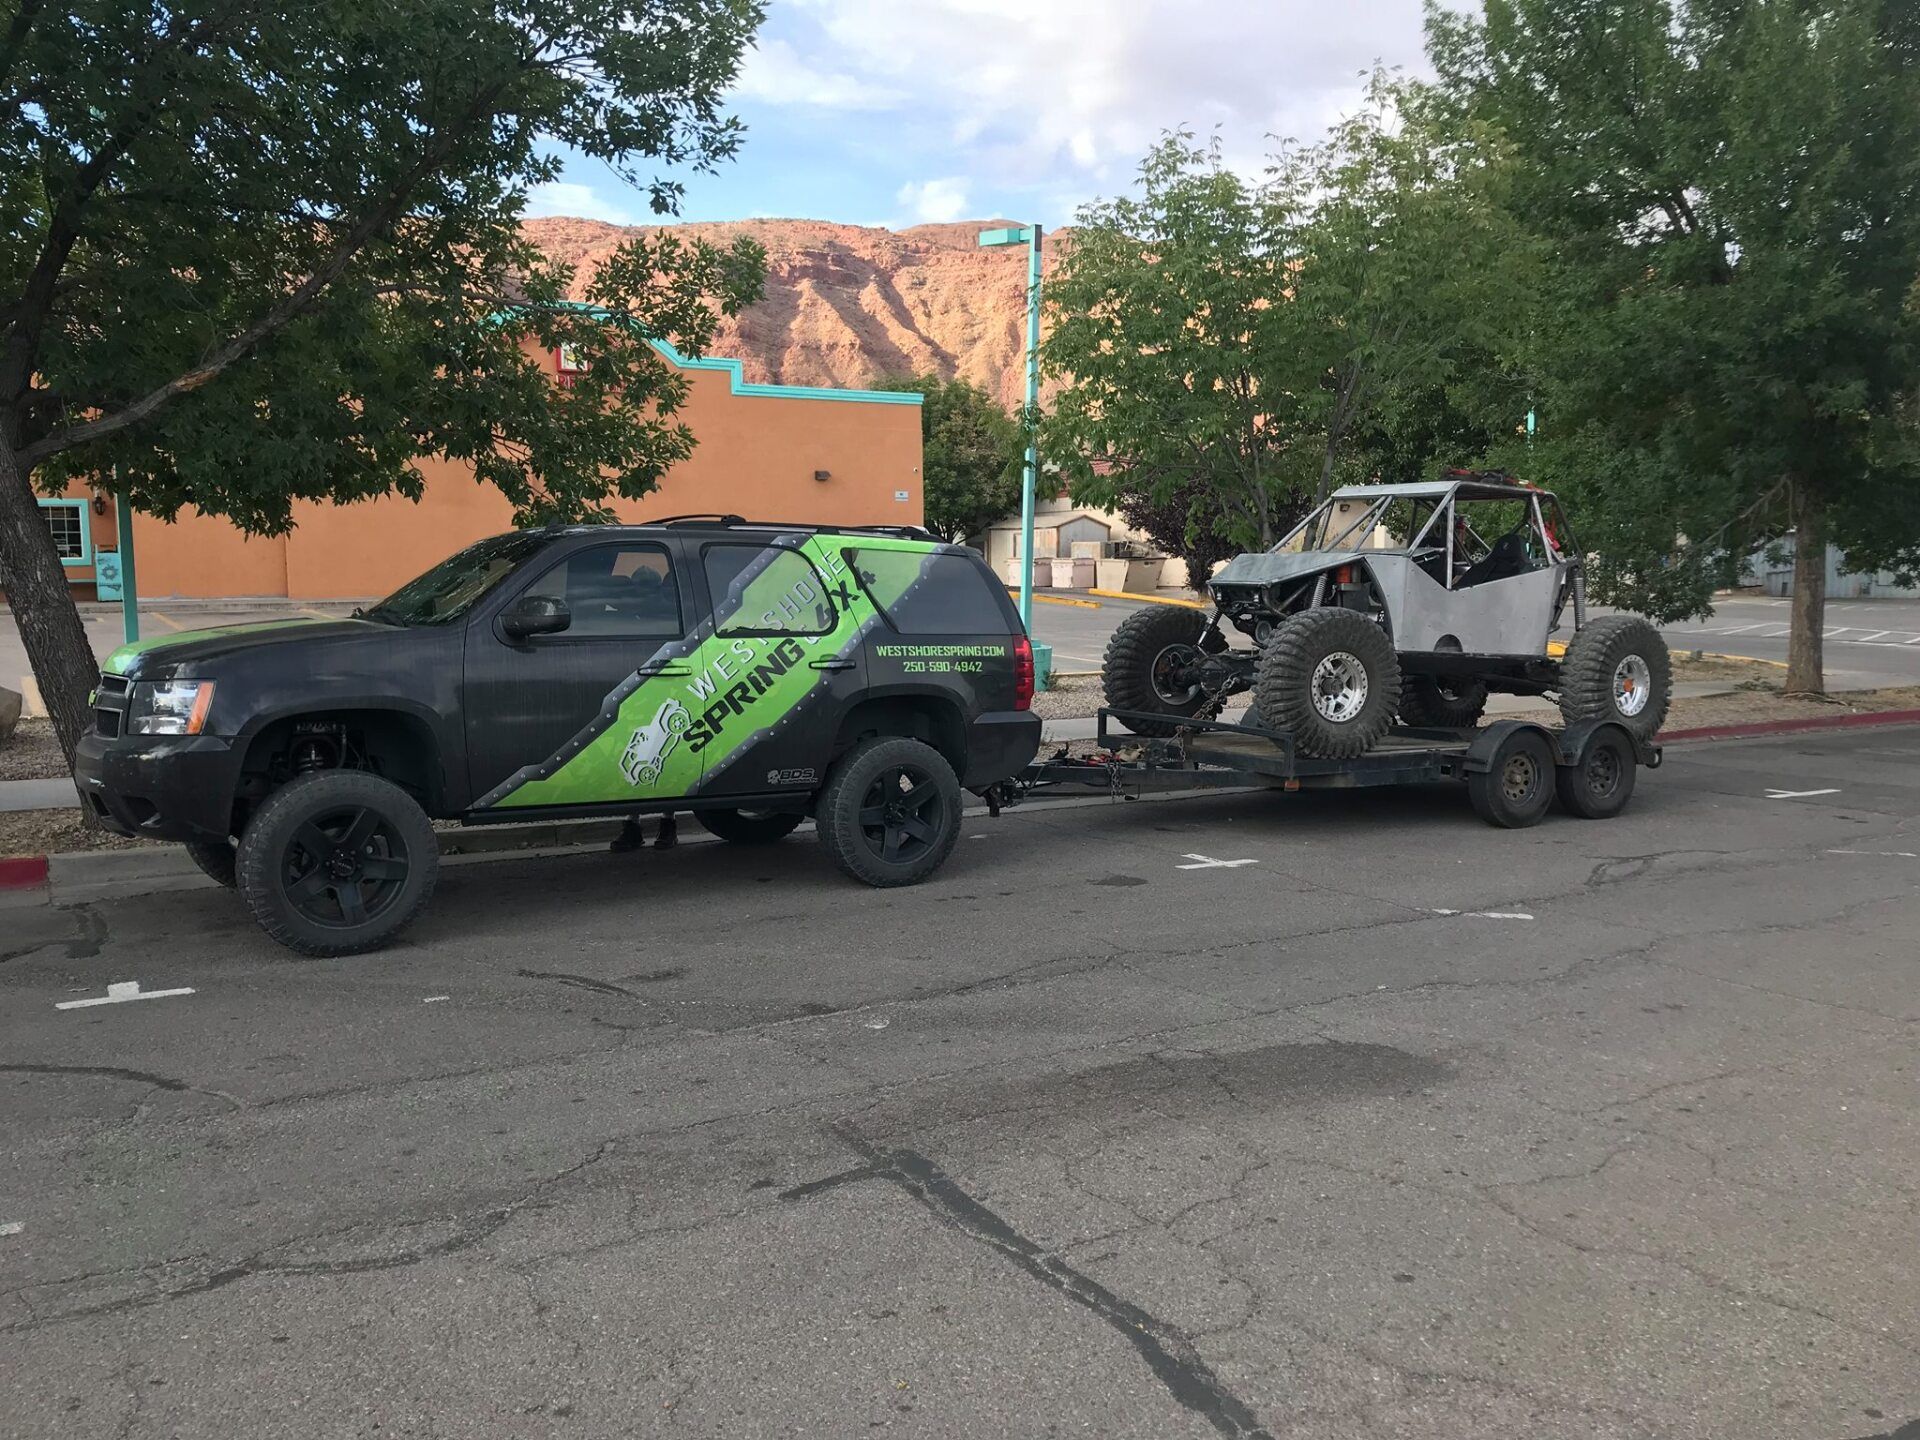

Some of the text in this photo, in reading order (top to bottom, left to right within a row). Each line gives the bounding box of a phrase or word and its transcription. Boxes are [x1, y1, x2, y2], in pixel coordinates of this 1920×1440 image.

[876, 645, 1005, 657] WESTSHORESPRINGCOM
[903, 661, 983, 672] 250-590-4942
[683, 638, 806, 753] SPRING
